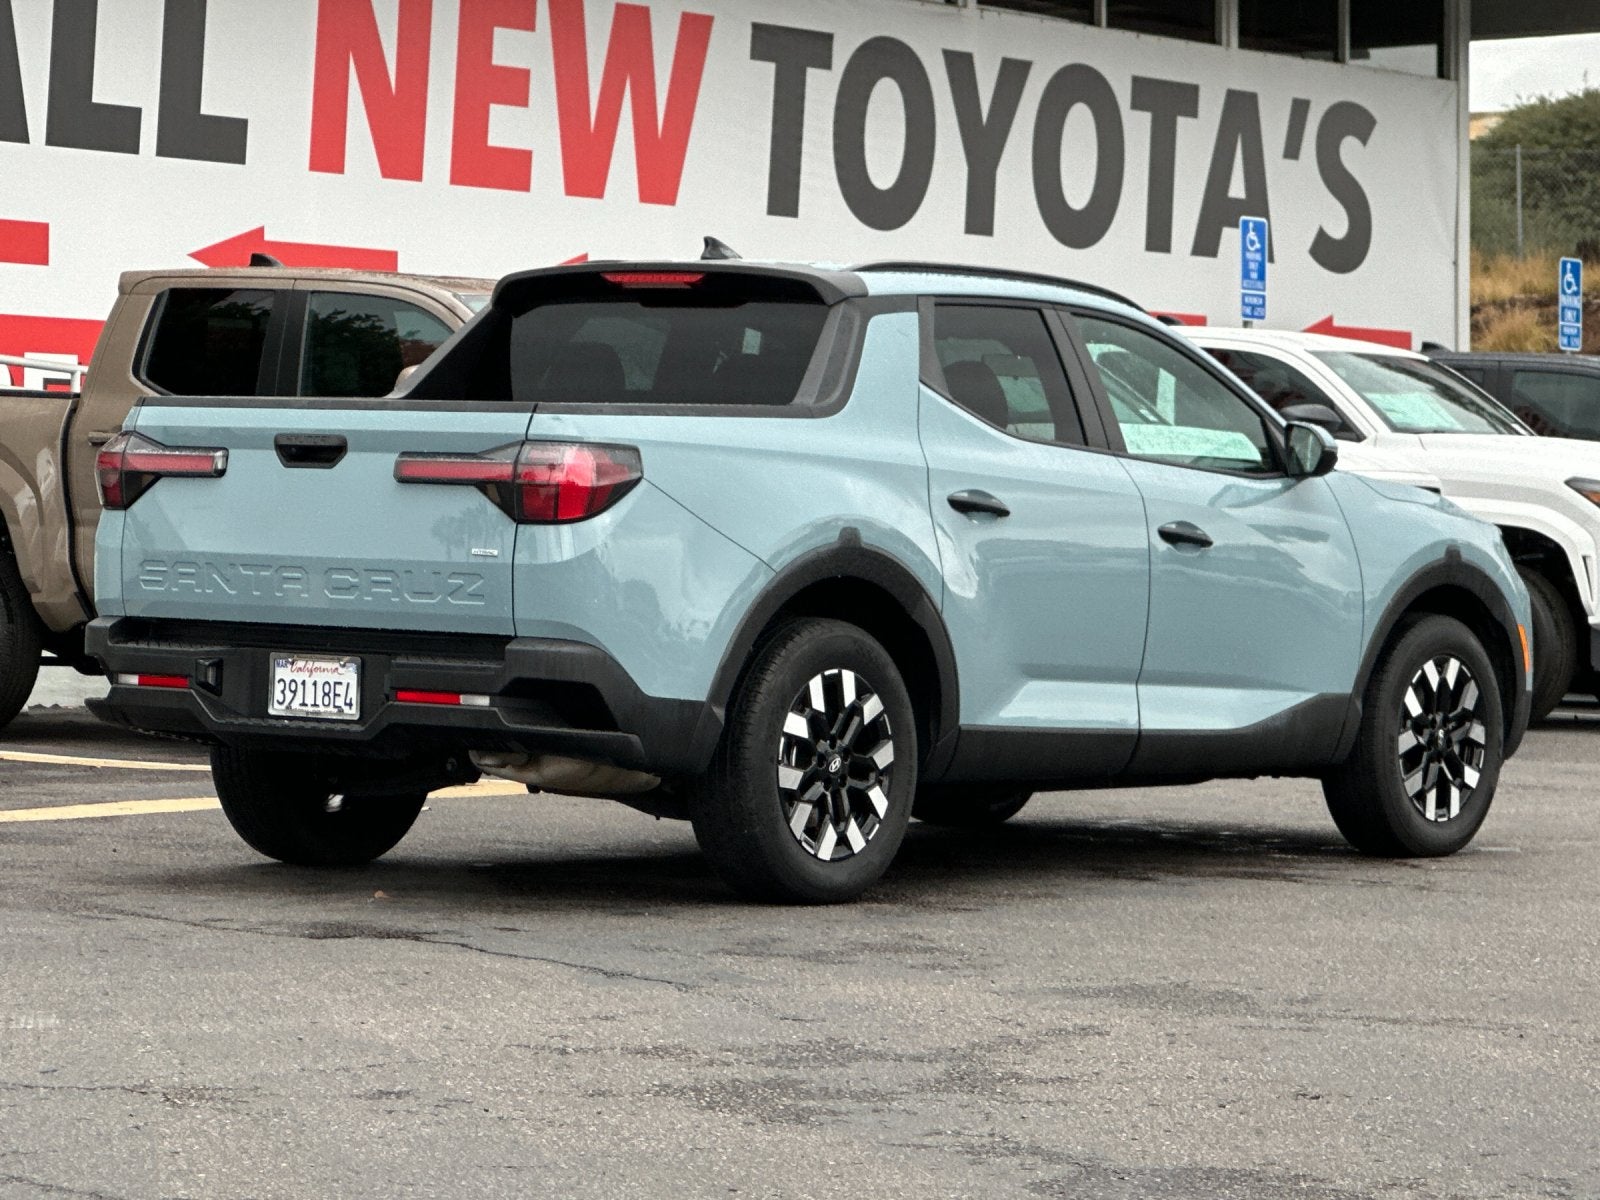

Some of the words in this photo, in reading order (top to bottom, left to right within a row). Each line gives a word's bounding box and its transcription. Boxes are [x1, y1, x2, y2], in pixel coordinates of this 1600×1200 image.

[308, 0, 715, 207] NEW
[749, 21, 1378, 275] TOYOTA'S
[139, 559, 309, 597] SANTA
[324, 567, 485, 605] CRUZ
[290, 659, 344, 678] California
[276, 677, 353, 711] 39118E4
